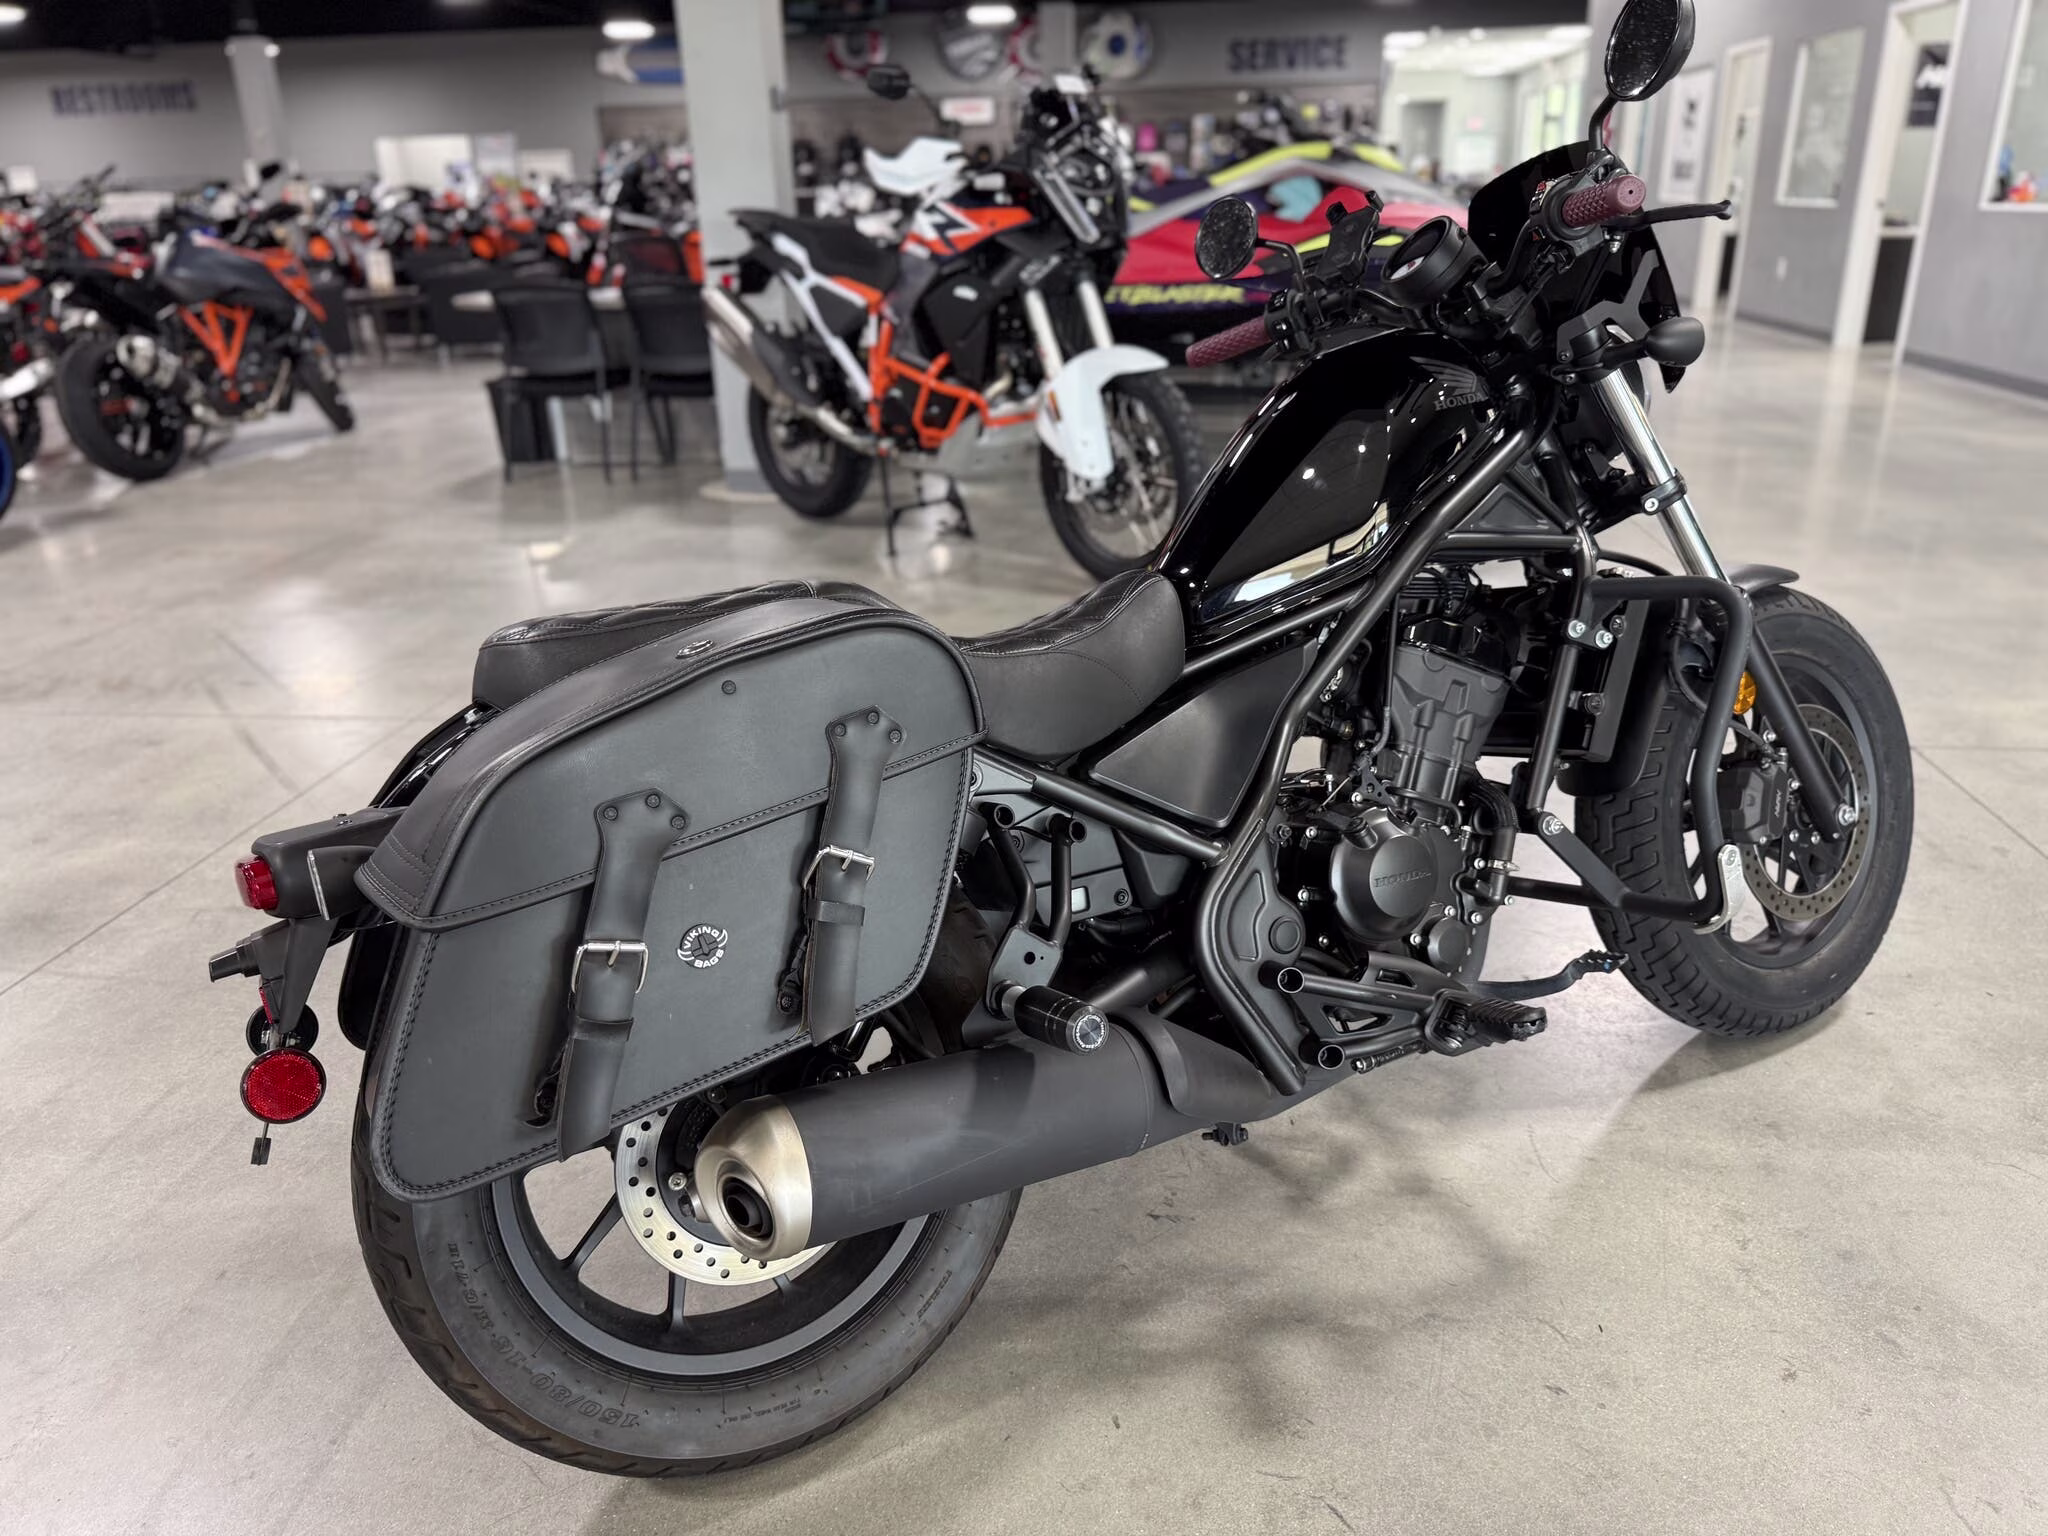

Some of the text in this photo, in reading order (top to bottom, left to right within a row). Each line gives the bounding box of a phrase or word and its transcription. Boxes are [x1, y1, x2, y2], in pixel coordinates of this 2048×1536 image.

[1230, 35, 1348, 74] SERVICE
[1433, 391, 1489, 412] HONDA
[683, 925, 725, 968] VIKING BAGS
